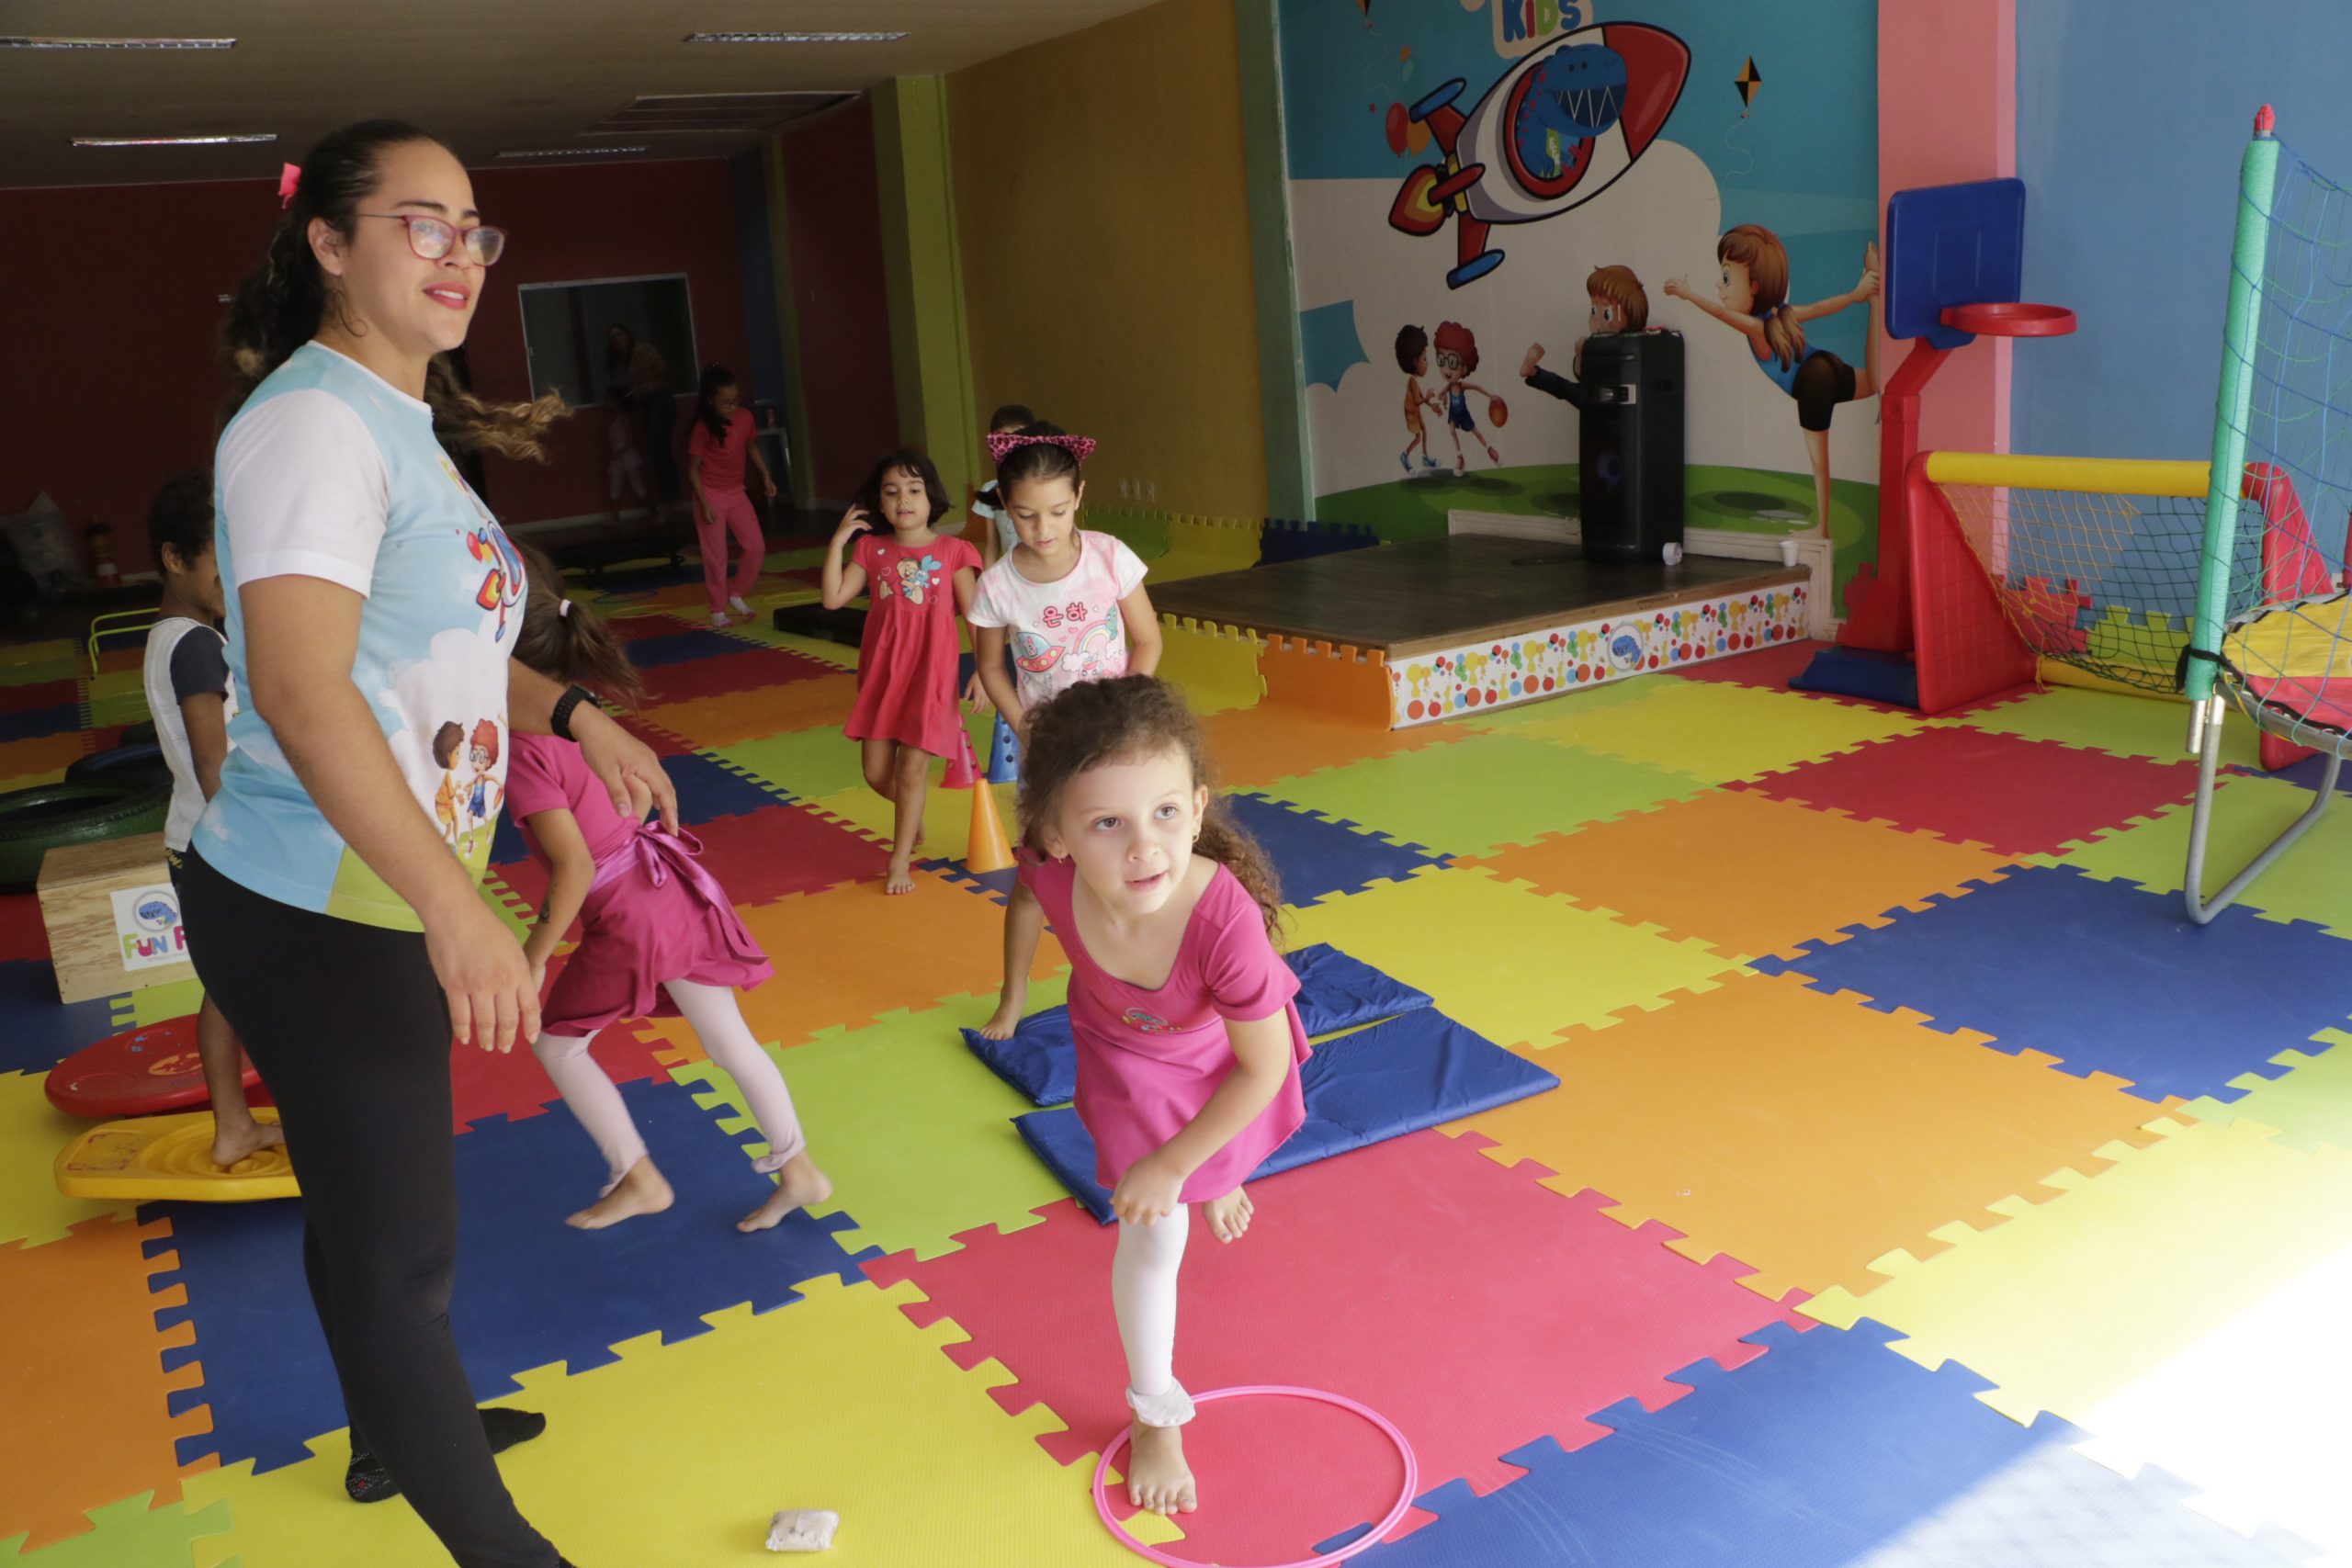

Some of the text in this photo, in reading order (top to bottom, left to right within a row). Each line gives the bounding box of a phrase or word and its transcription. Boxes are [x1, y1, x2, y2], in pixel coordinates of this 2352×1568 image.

[1502, 0, 1581, 42] KIDS
[1043, 602, 1088, 628] 은하
[122, 933, 169, 960] FUN
